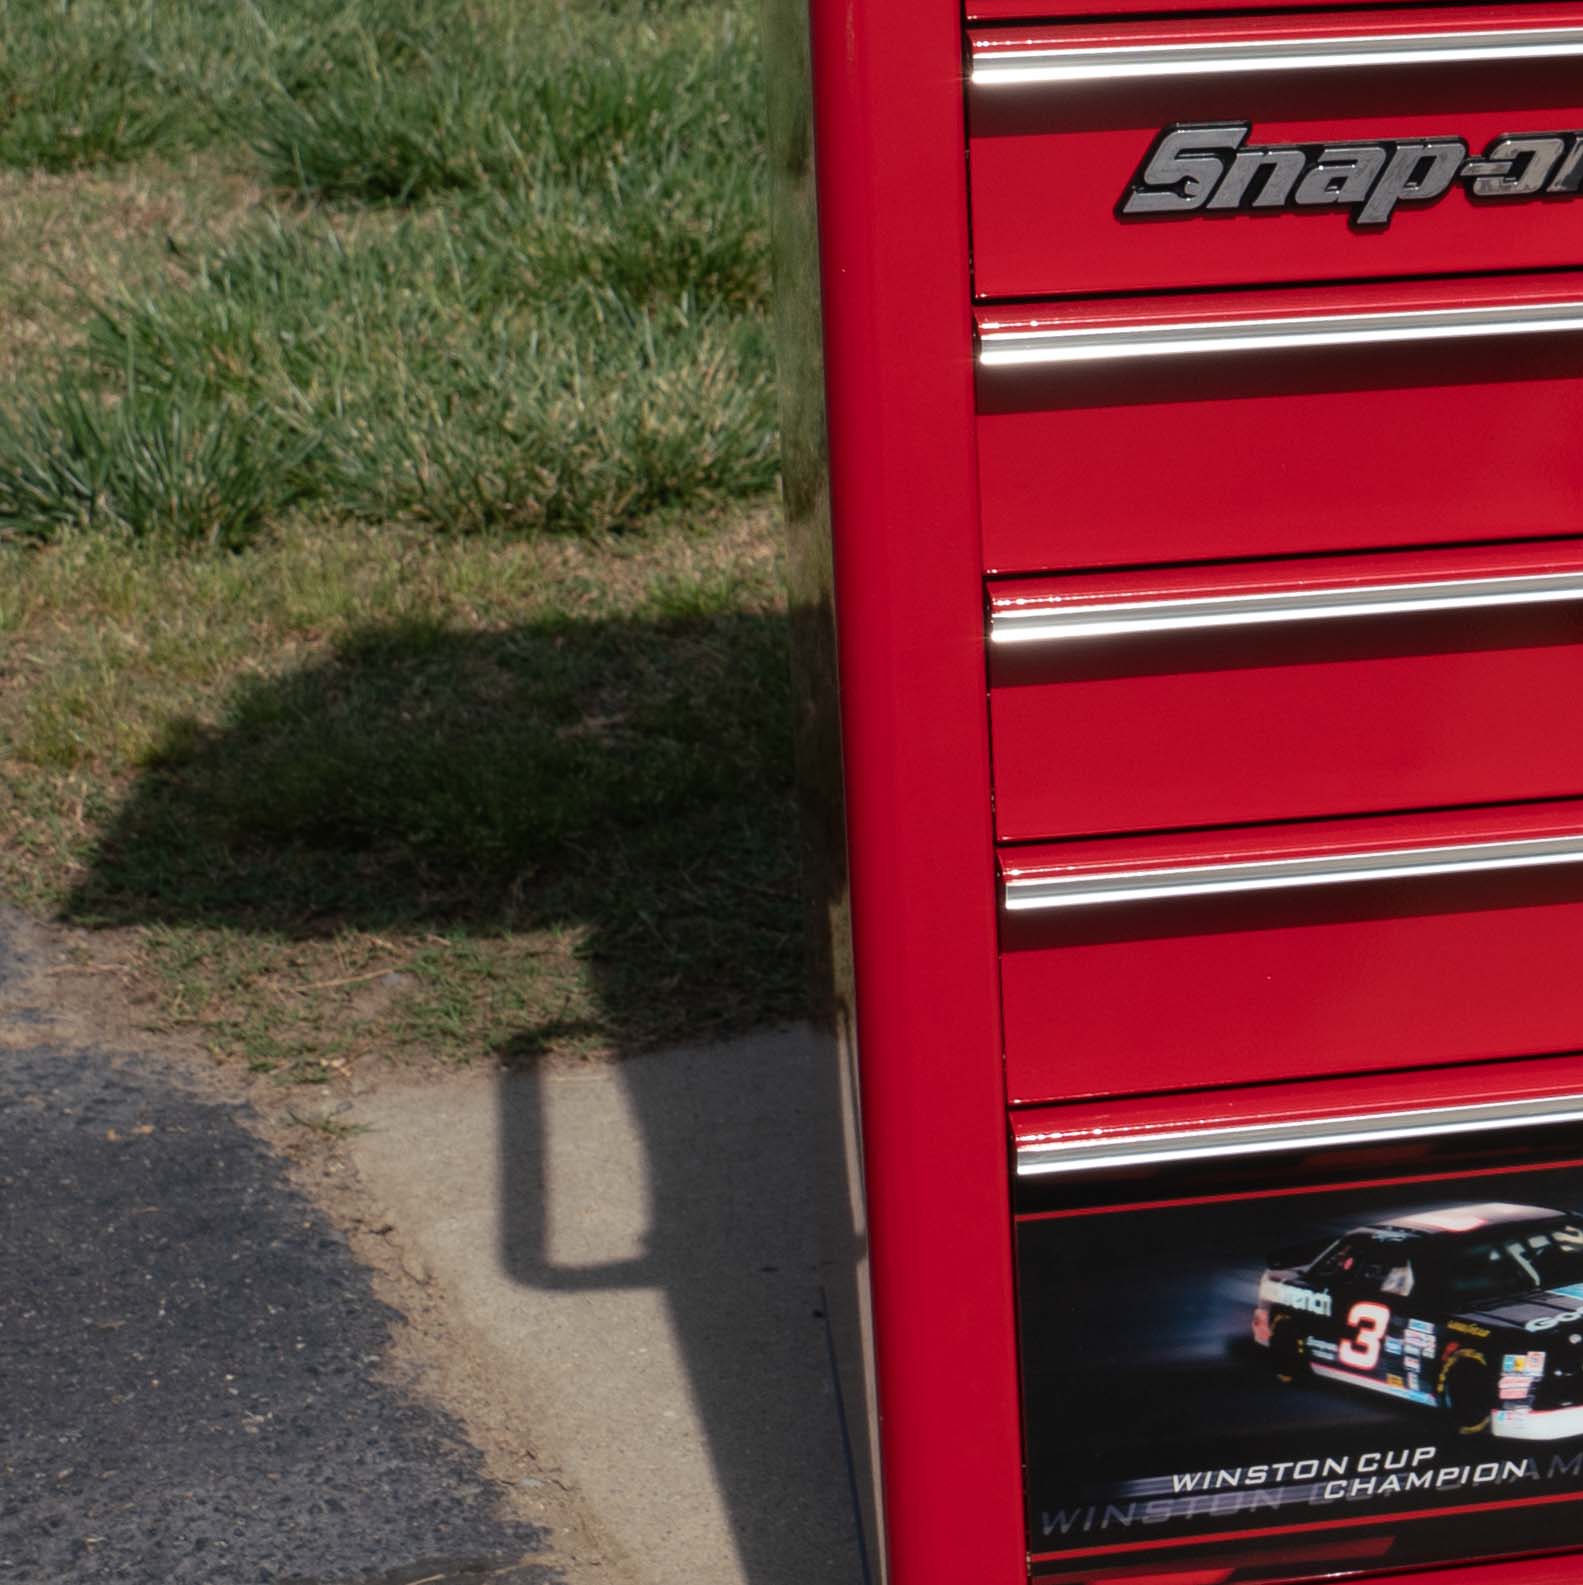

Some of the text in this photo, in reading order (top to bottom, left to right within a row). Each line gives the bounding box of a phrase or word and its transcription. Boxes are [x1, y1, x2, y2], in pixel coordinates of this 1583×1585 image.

[1339, 1300, 1391, 1371] 3
[1170, 1446, 1438, 1493] WINSTON CUP
[1321, 1458, 1530, 1500] CHAMPION
